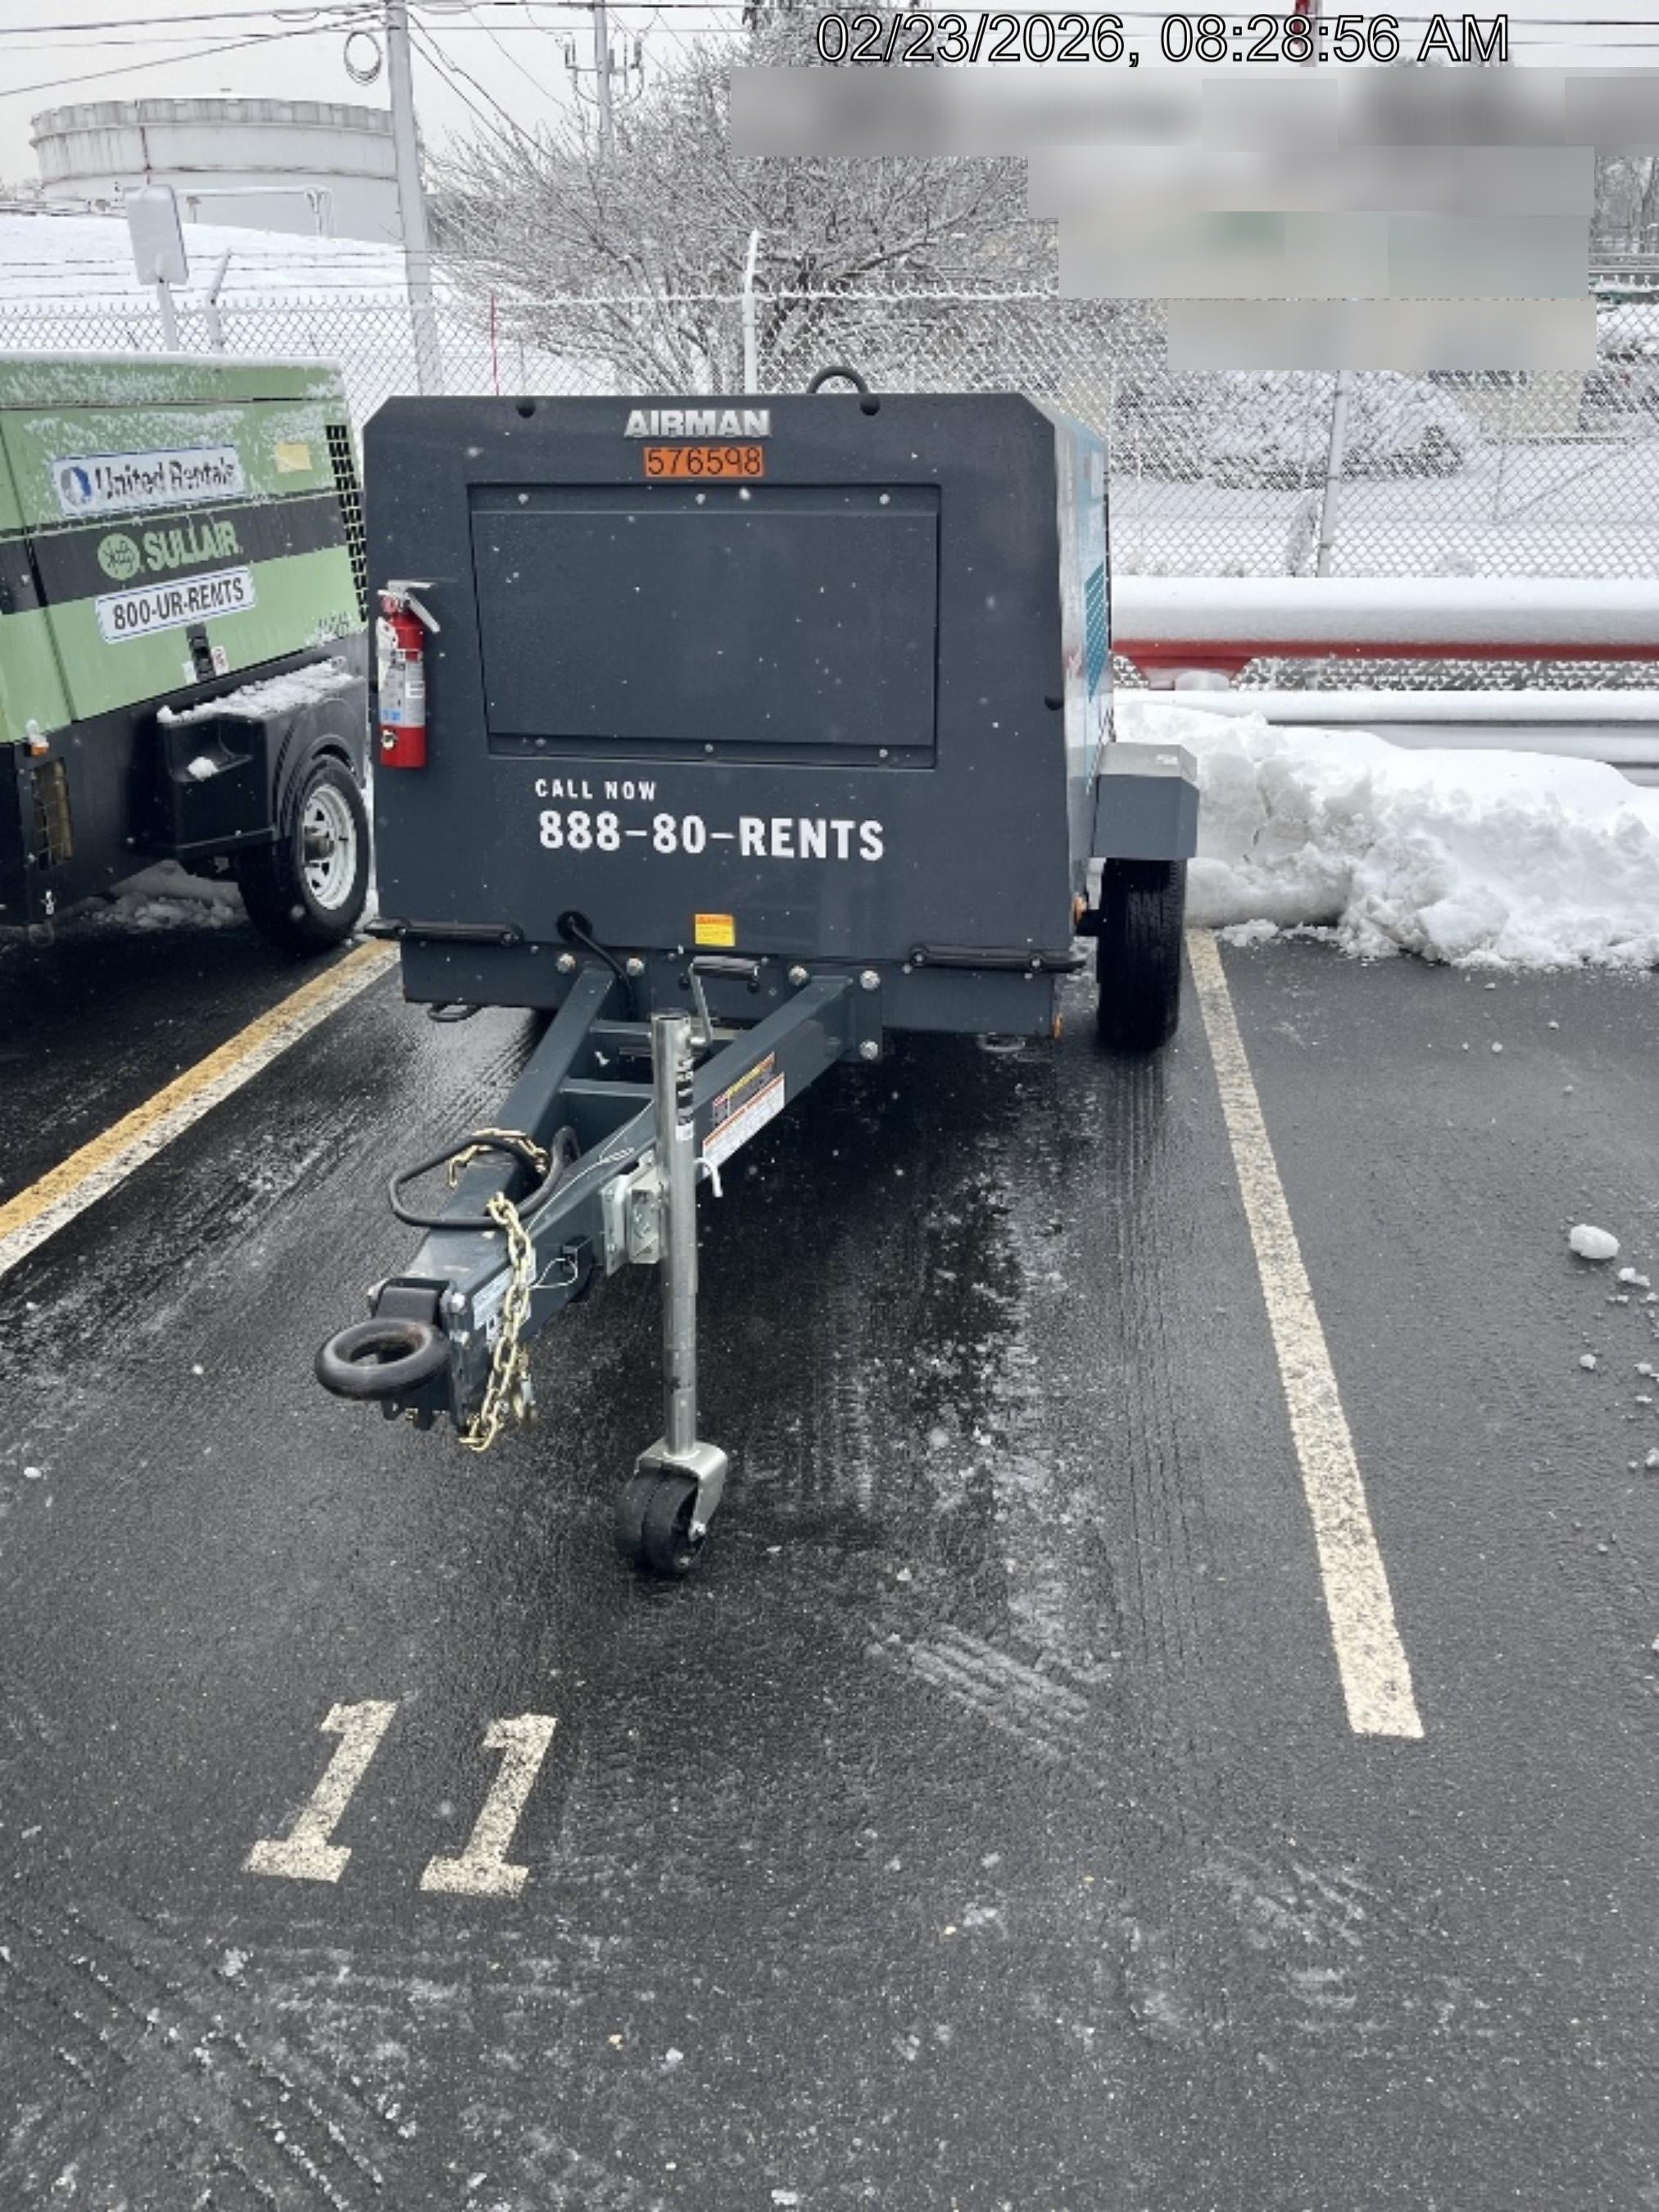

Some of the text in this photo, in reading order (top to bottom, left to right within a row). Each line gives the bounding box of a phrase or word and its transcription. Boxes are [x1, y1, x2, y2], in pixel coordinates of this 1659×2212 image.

[623, 409, 773, 438] AIRMAN
[95, 461, 165, 500] United
[647, 446, 761, 475] 576598
[143, 519, 238, 572] SULLAIR
[113, 577, 244, 631] 800-UR-RENTS
[535, 778, 656, 801] CALL NOW
[539, 809, 885, 862] 888-80-RENTS
[241, 1699, 560, 1899] 11
